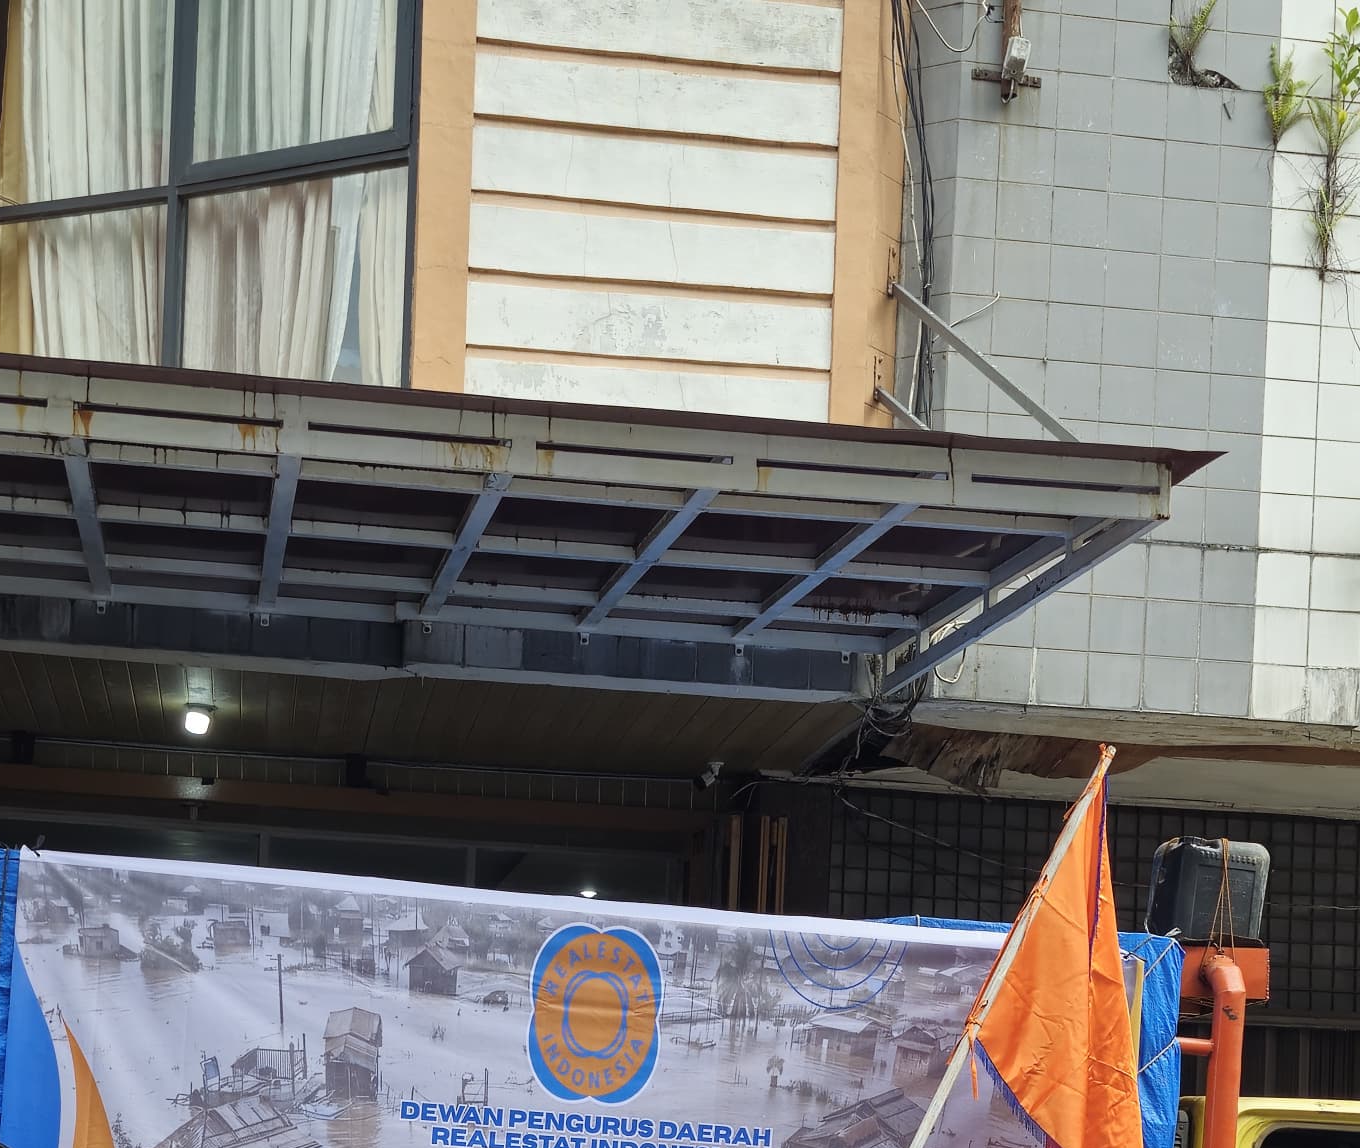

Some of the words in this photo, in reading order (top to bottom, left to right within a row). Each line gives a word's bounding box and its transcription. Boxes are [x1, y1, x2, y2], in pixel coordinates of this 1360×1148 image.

[545, 941, 649, 1002] REALESTAT
[542, 1033, 645, 1089] INDONESIA
[401, 1101, 504, 1127] DEWAN
[508, 1109, 654, 1139] PENGURUS
[658, 1121, 772, 1148] DAERAH
